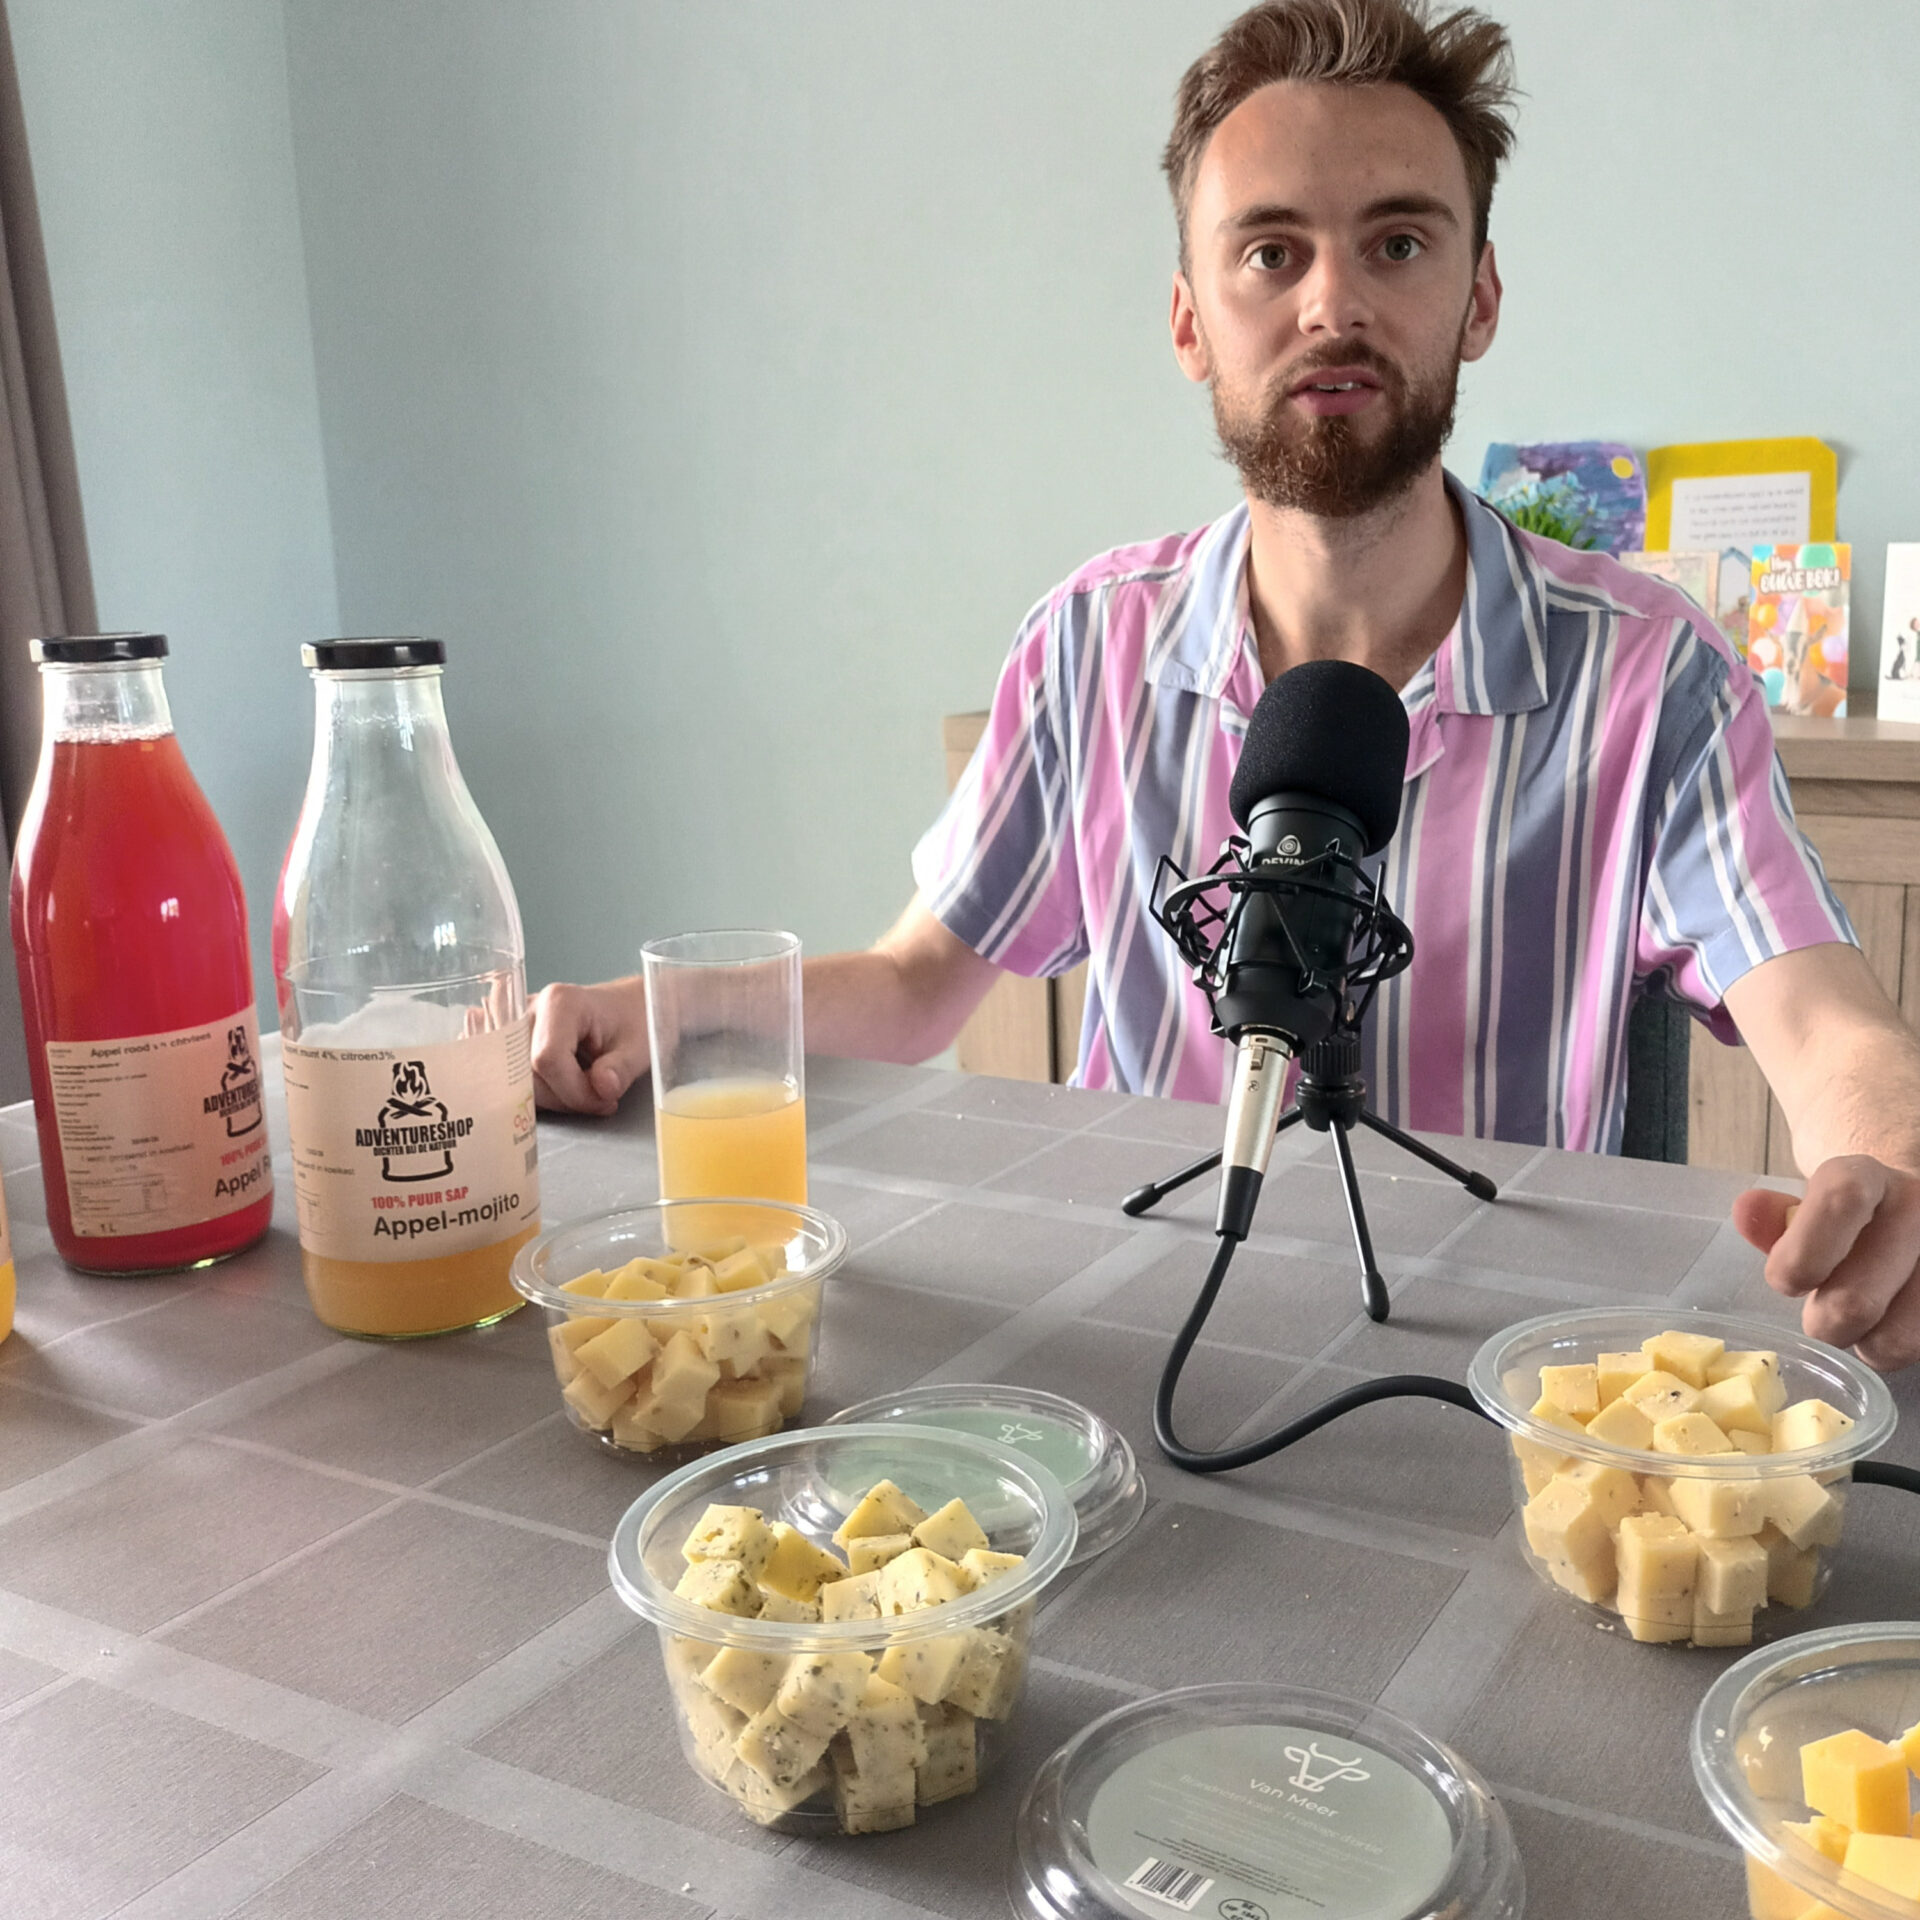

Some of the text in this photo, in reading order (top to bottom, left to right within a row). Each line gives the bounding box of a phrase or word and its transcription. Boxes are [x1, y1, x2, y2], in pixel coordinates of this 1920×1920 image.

[1262, 857, 1306, 866] DEVIN
[356, 1117, 474, 1147] ADVENTURESHOP
[215, 1162, 262, 1197] Appel
[371, 1186, 469, 1209] 100% PUUR SAP
[373, 1193, 520, 1240] Appel-mojito
[1249, 1778, 1340, 1818] Van Meer
